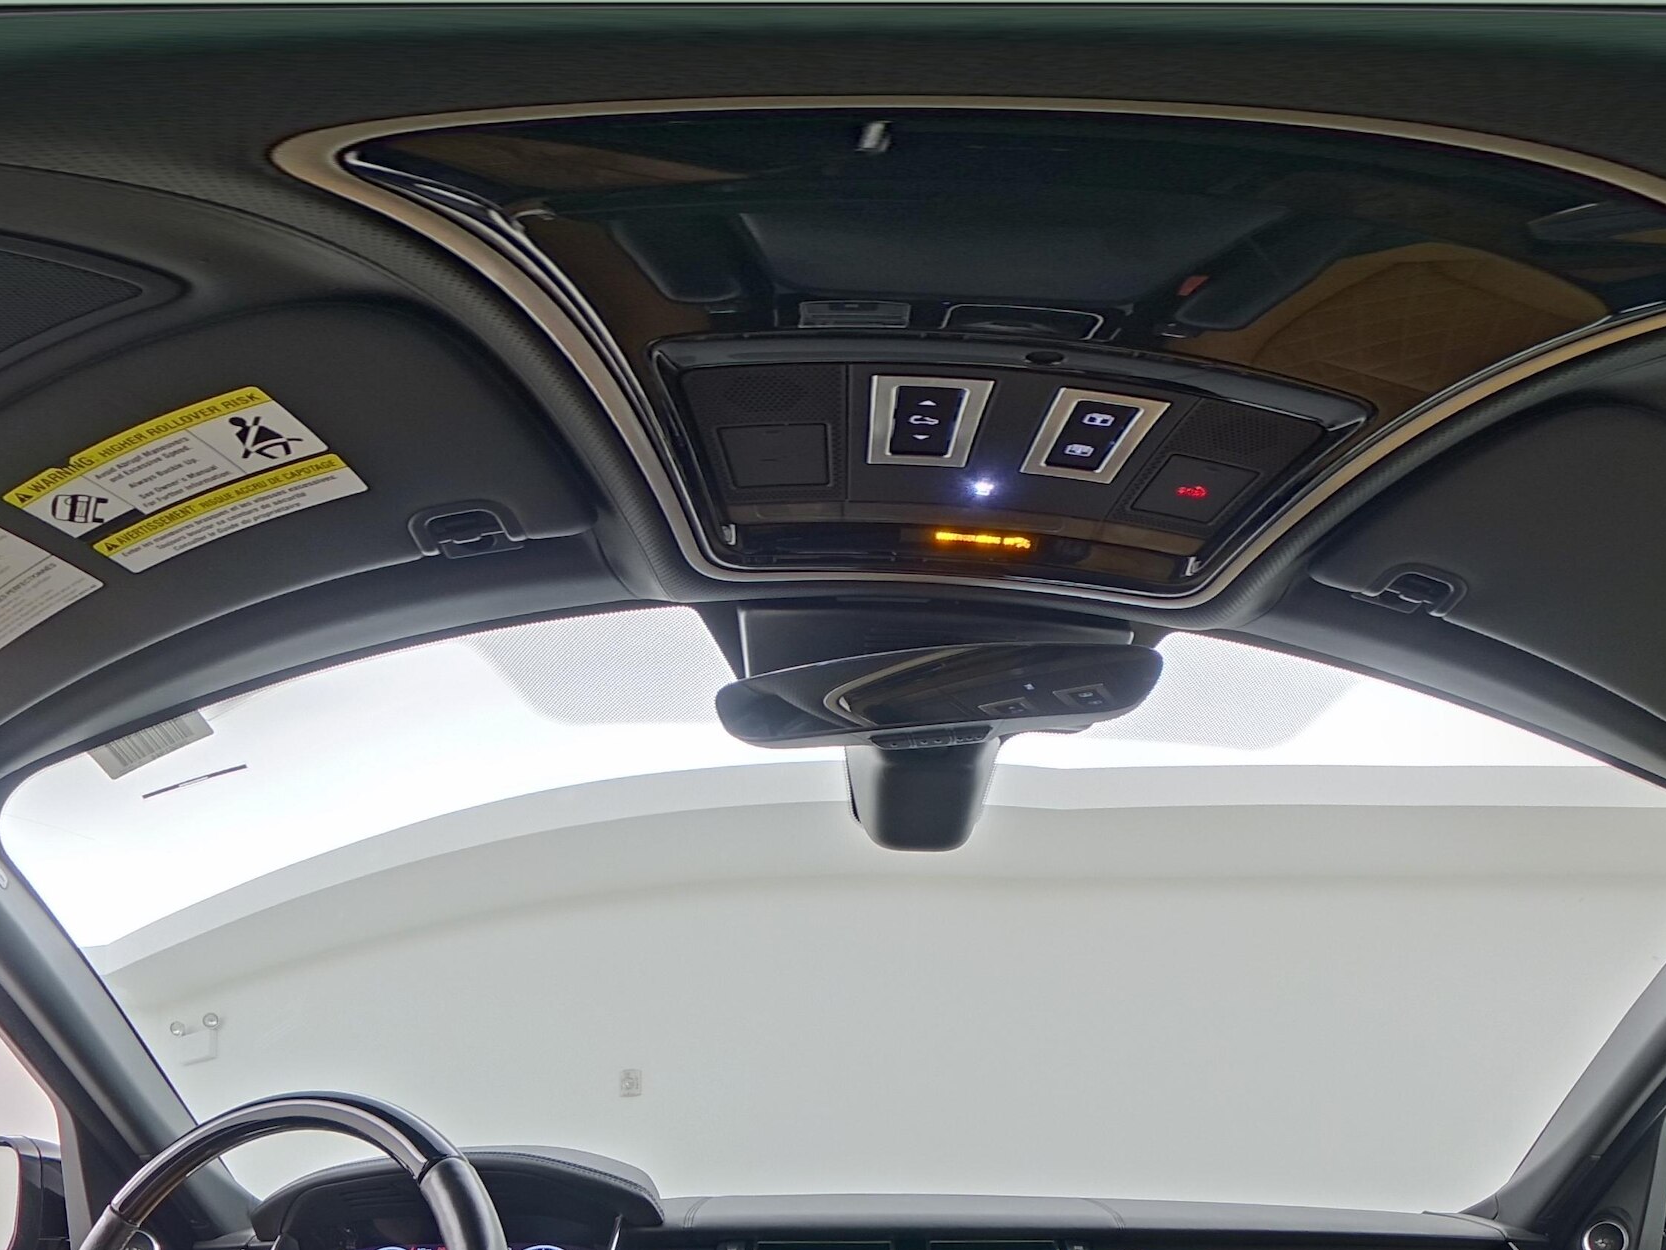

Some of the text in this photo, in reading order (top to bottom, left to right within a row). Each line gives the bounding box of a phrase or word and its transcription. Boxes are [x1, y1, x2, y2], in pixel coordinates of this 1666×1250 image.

[99, 433, 148, 458] HIGHER
[148, 403, 219, 436] ROLLOVER
[223, 392, 261, 411] RISK
[198, 492, 235, 508] RISQUE
[234, 480, 268, 495] ACCRU
[267, 476, 283, 485] DE
[282, 460, 337, 480] CAPOTAGE
